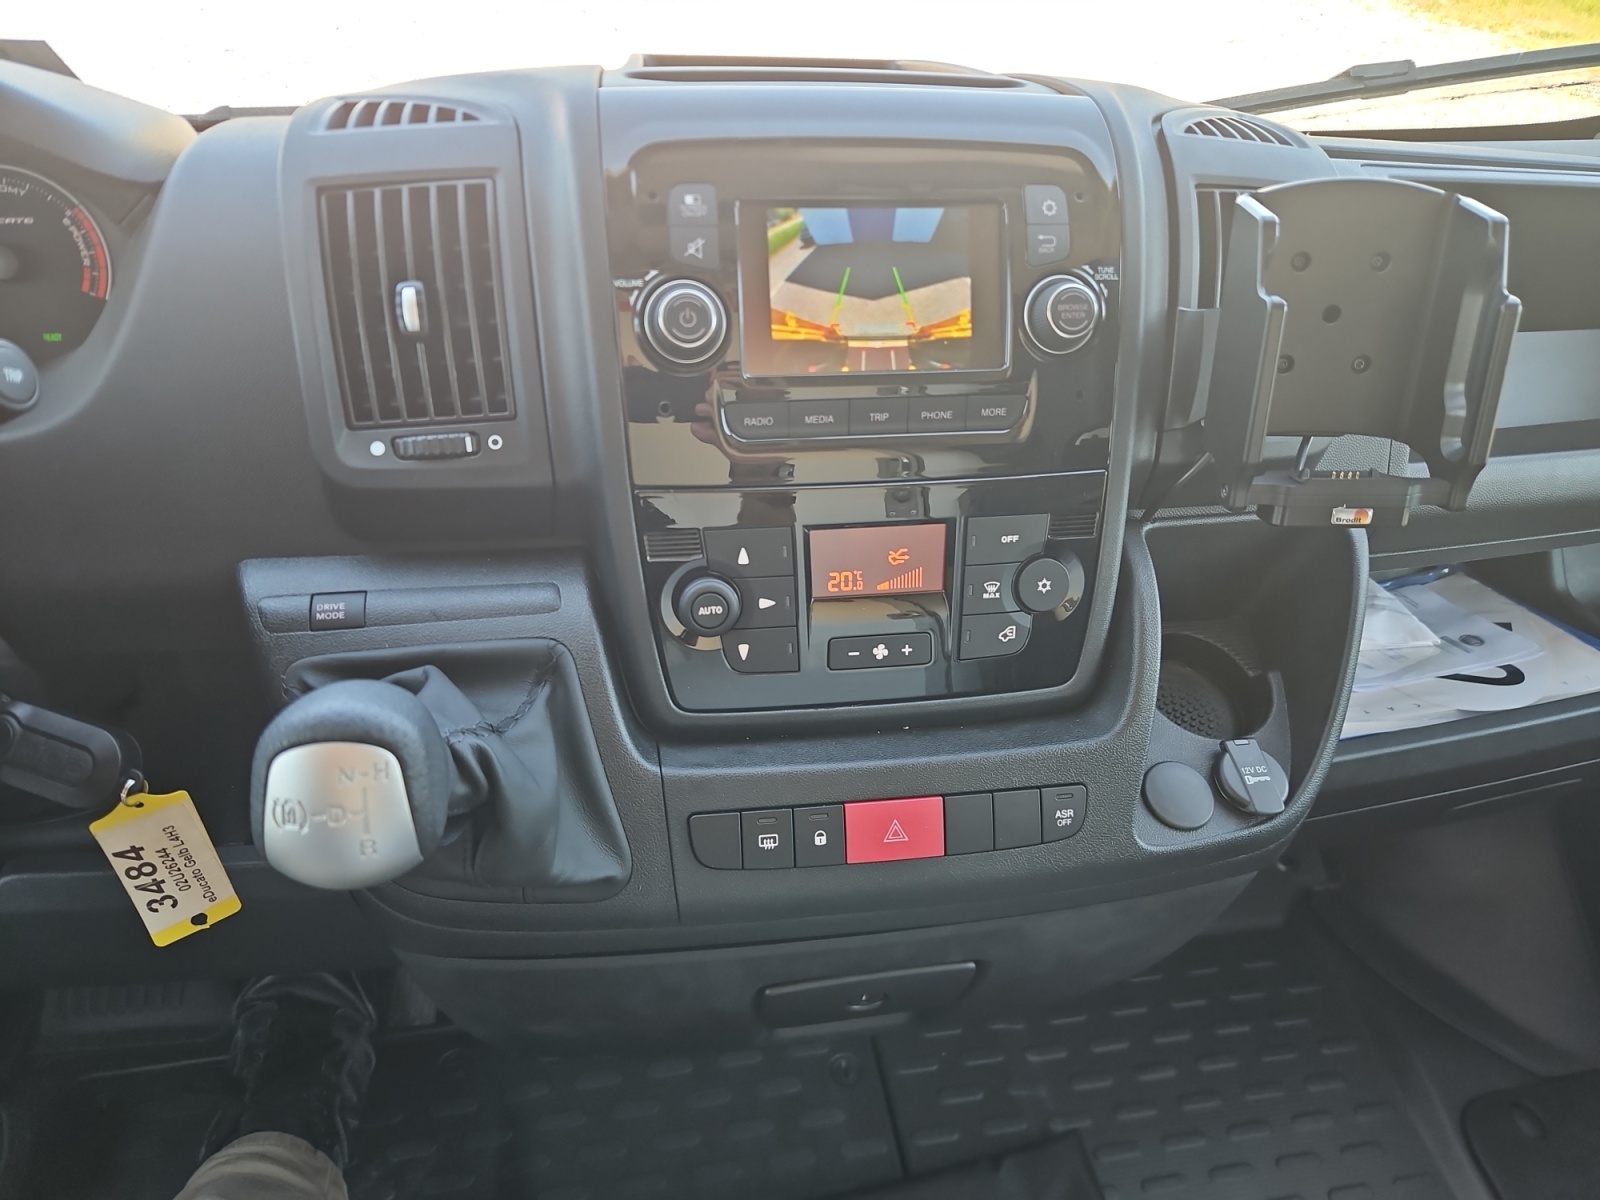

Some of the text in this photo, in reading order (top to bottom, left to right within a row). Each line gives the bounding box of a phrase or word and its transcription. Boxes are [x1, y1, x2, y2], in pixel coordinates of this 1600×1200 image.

[1098, 266, 1114, 274] TUNE
[613, 279, 644, 287] VOLUME
[869, 412, 889, 422] TRIP
[920, 410, 953, 420] PHONE
[981, 407, 1007, 417] MORE
[743, 416, 774, 427] RADIO
[804, 414, 834, 425] MEDIA
[1001, 535, 1020, 544] OFF
[316, 602, 346, 611] DRIVE
[698, 605, 723, 616] AUTO
[316, 611, 345, 620] MODE
[1241, 765, 1268, 775] 12V DC
[1055, 808, 1074, 819] ASR
[1056, 819, 1072, 827] OFF
[162, 825, 218, 903] eDucato Gelb L4H3
[155, 847, 192, 892] 02U26244
[111, 845, 178, 913] 3484
